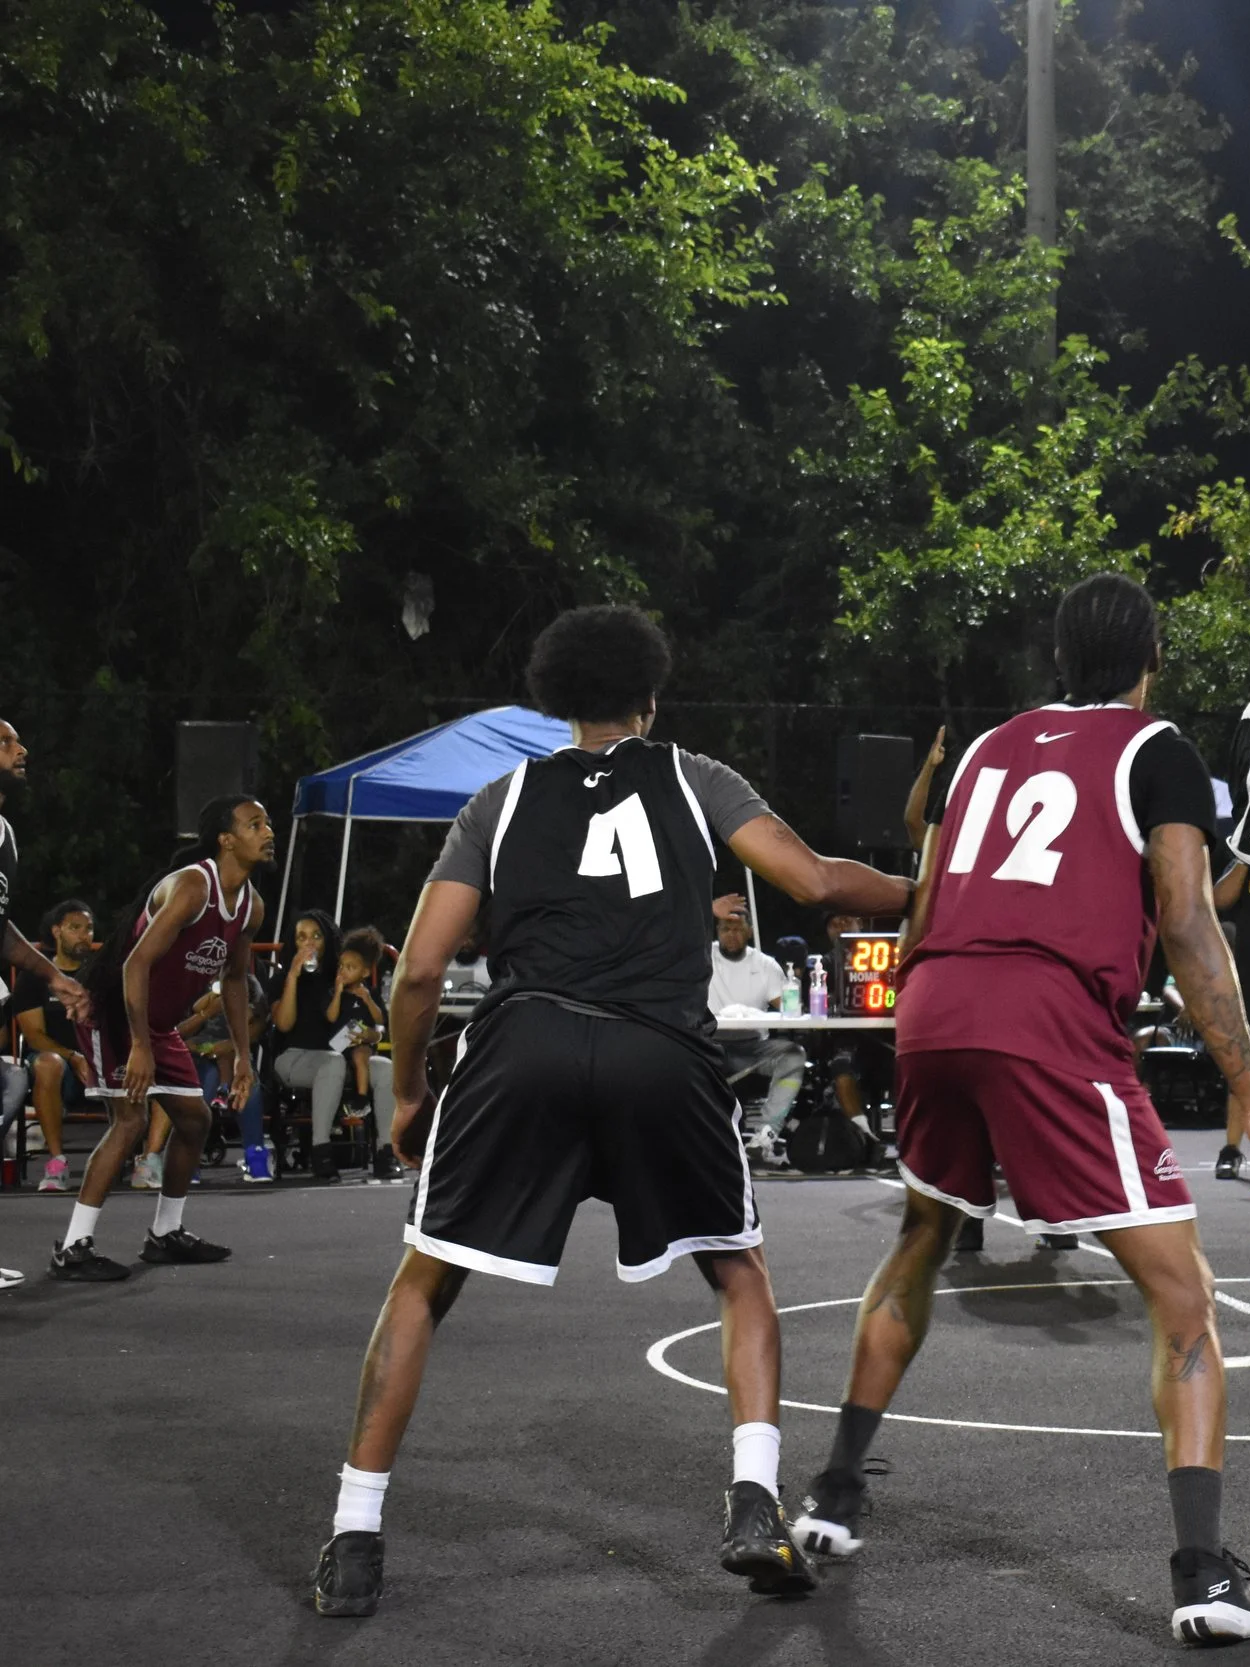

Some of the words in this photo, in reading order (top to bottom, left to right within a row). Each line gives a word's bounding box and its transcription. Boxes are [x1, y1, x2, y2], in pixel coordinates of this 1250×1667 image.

[577, 792, 663, 898] 4
[948, 766, 1077, 886] 12
[849, 972, 880, 982] HOME
